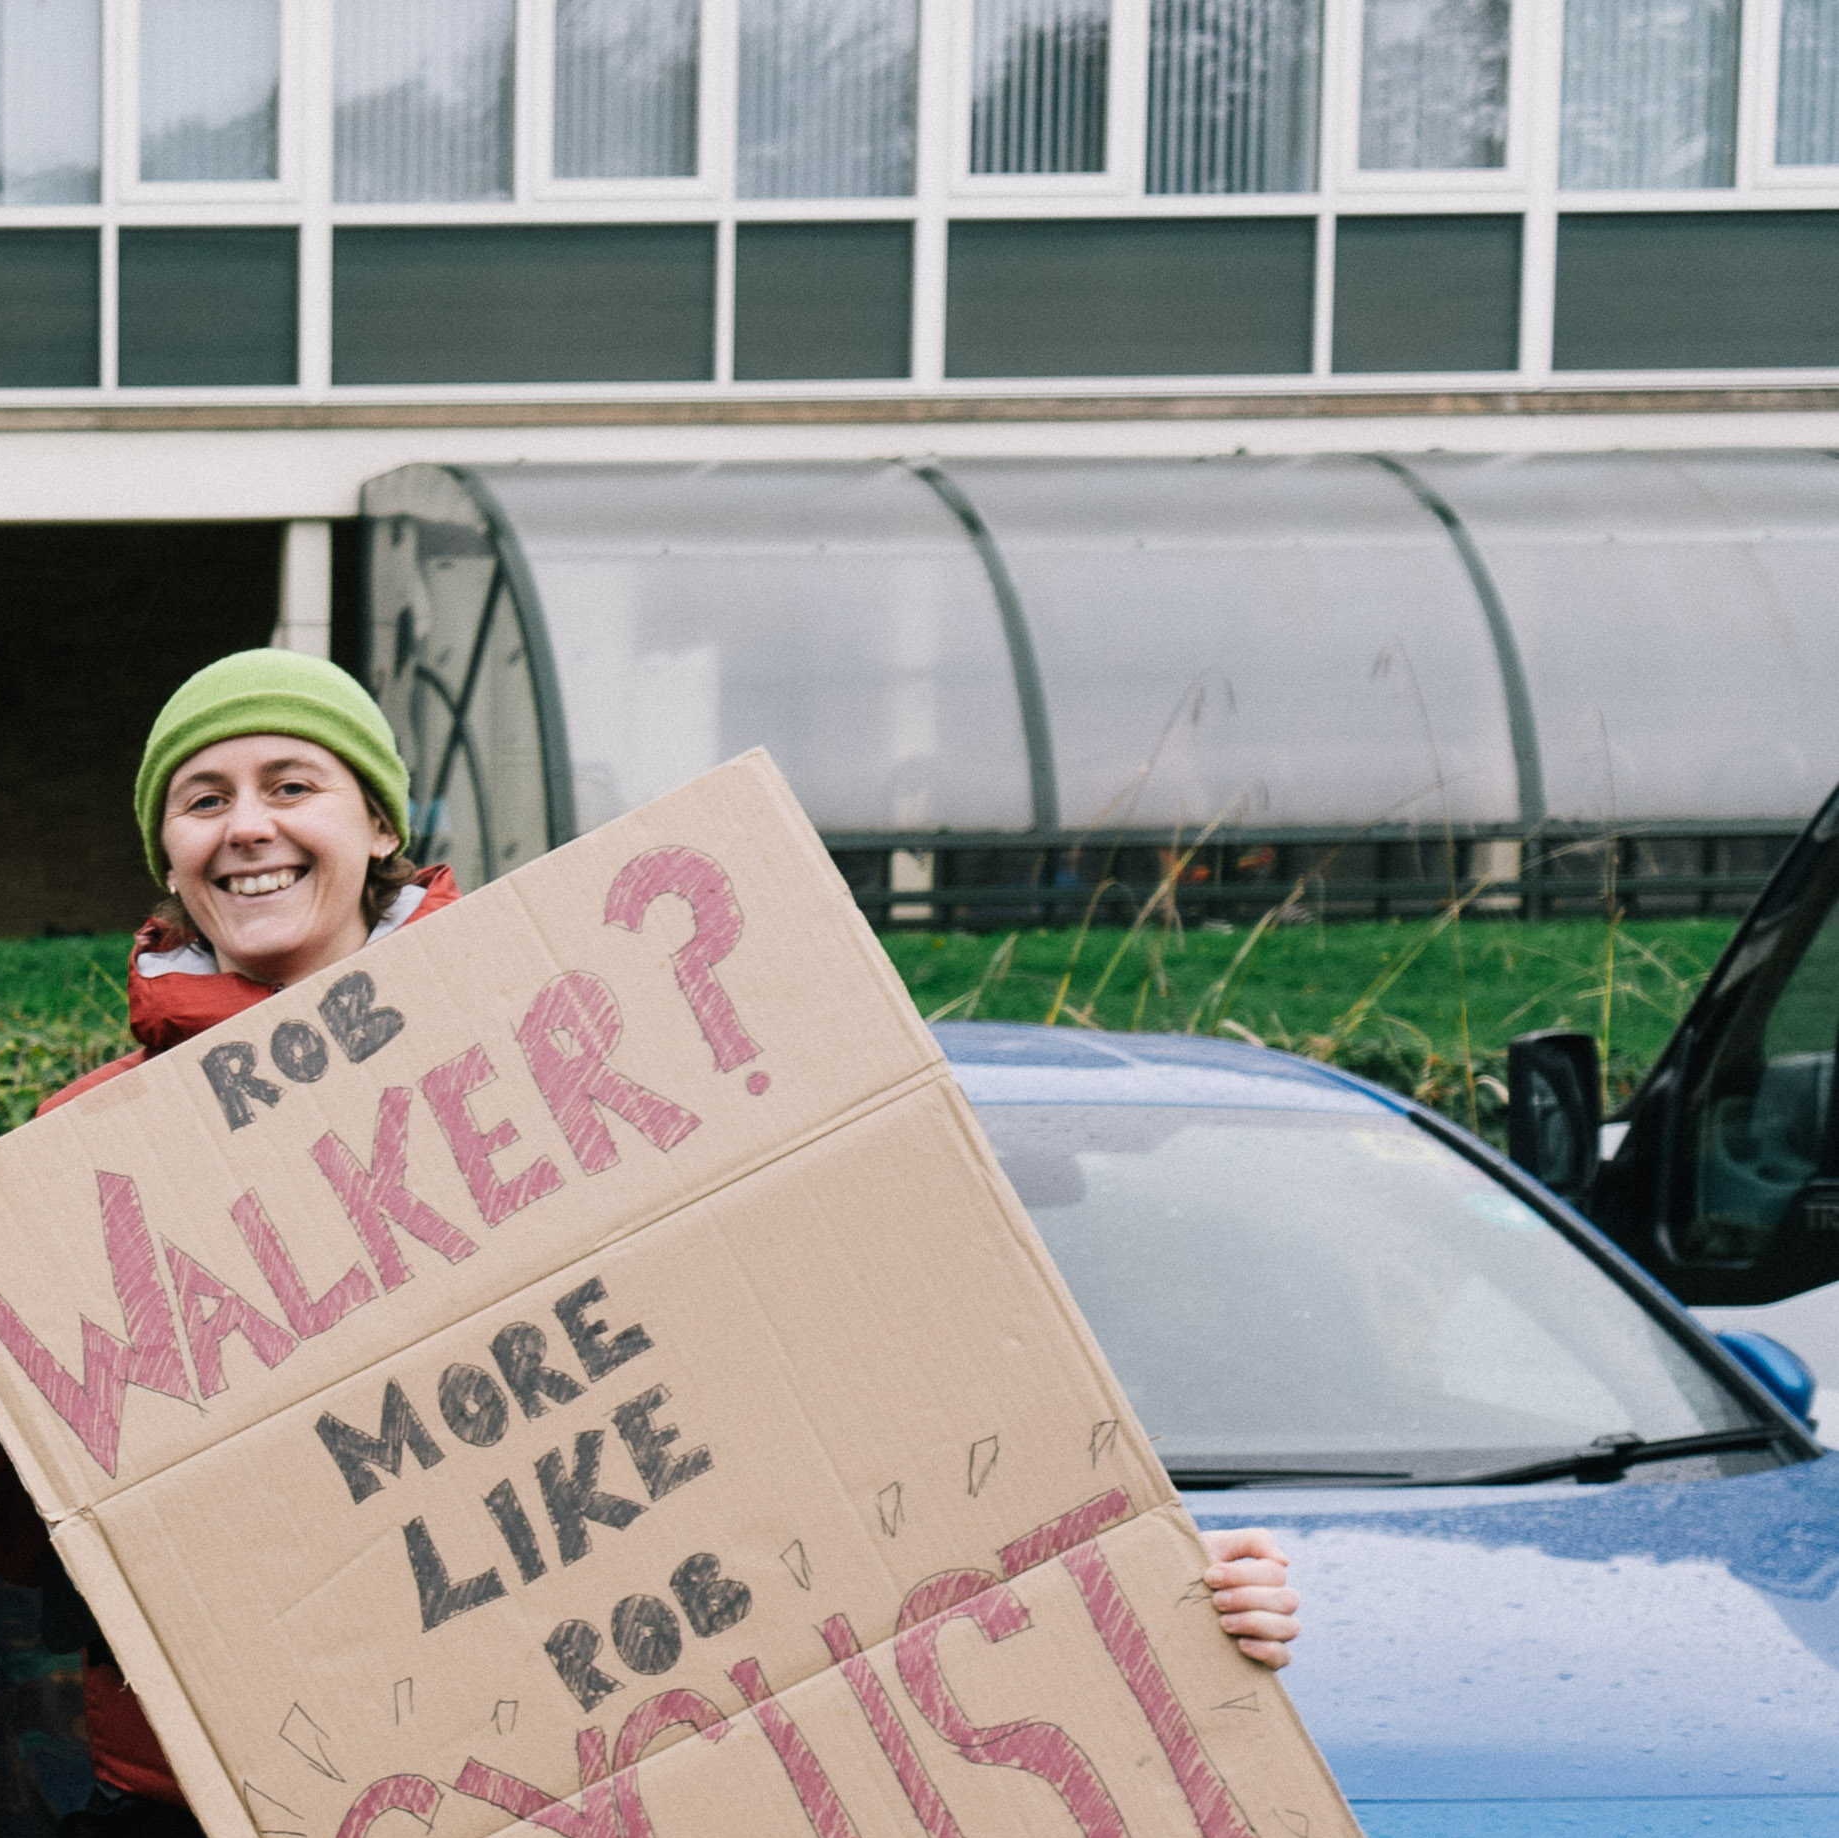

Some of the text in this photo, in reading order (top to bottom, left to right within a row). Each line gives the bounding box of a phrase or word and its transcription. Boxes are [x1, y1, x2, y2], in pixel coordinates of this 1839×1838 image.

[199, 969, 406, 1133] ROB
[312, 1275, 654, 1504] MORE
[401, 1383, 714, 1633] LIKE
[542, 1552, 754, 1711] ROB
